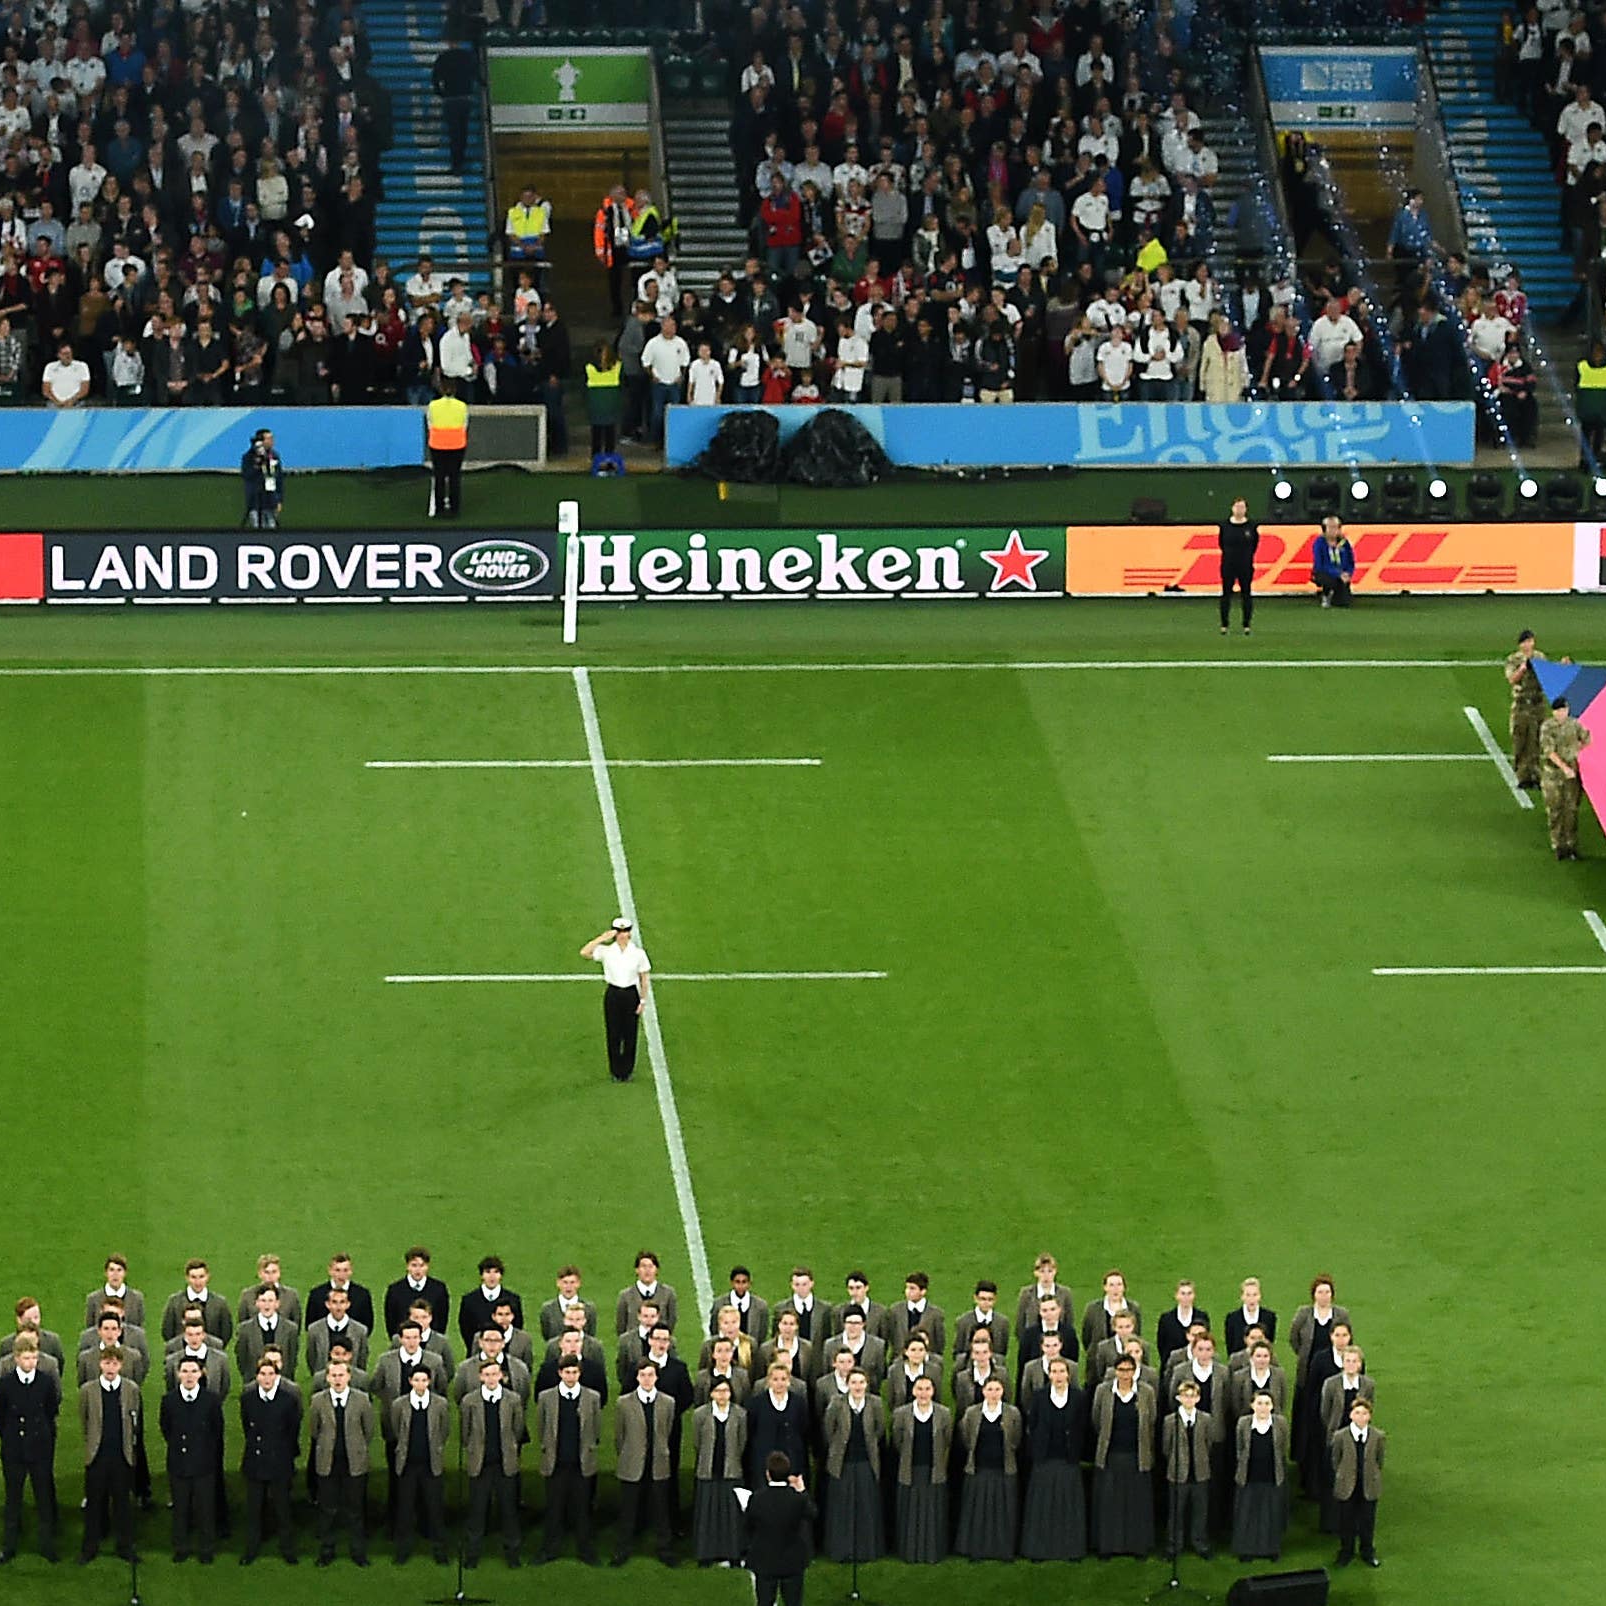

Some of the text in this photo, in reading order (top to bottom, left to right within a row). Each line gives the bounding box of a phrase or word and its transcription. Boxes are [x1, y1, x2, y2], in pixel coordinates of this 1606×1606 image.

[51, 543, 444, 590] LAND ROVER
[578, 533, 965, 593] Heineken
[1176, 532, 1466, 584] DHL
